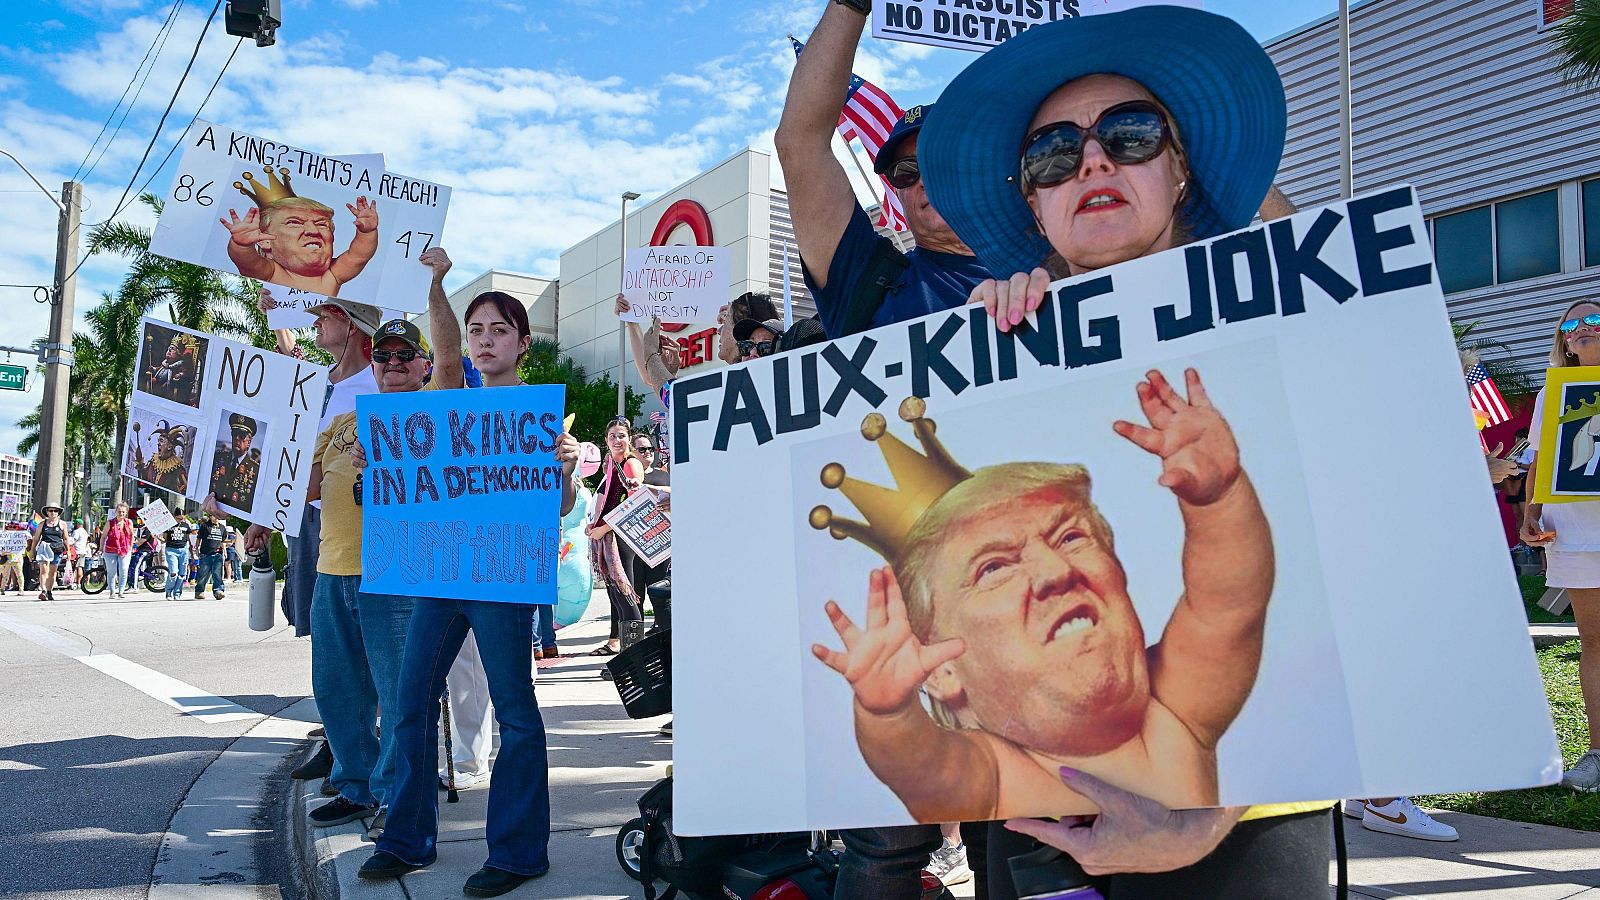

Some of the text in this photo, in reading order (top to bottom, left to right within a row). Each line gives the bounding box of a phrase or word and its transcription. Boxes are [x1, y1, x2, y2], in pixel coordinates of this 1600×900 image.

[886, 2, 1040, 42] NO DICTAT
[196, 126, 216, 151] A
[356, 169, 372, 191] A
[379, 174, 439, 207] REACH!
[173, 175, 215, 206] 86
[396, 230, 434, 259] 47
[645, 248, 714, 265] AFRAID OF
[625, 268, 713, 290] DICTATORSHIP
[271, 299, 299, 309] BRAVE
[632, 303, 699, 319] DIVERSITY
[648, 291, 674, 302] NOT
[672, 185, 1434, 465] FAUX-KING JOKE
[676, 328, 717, 369] GET
[0, 371, 23, 383] Ent
[217, 346, 265, 398] NO
[271, 363, 317, 532] KINGS
[369, 410, 436, 463] NO
[447, 409, 557, 458] KINGS
[372, 464, 563, 506] IN A DEMOCRACY
[620, 521, 632, 531] WE
[635, 503, 656, 520] PEOPLE
[625, 520, 650, 540] WILL
[366, 516, 469, 585] DUMP
